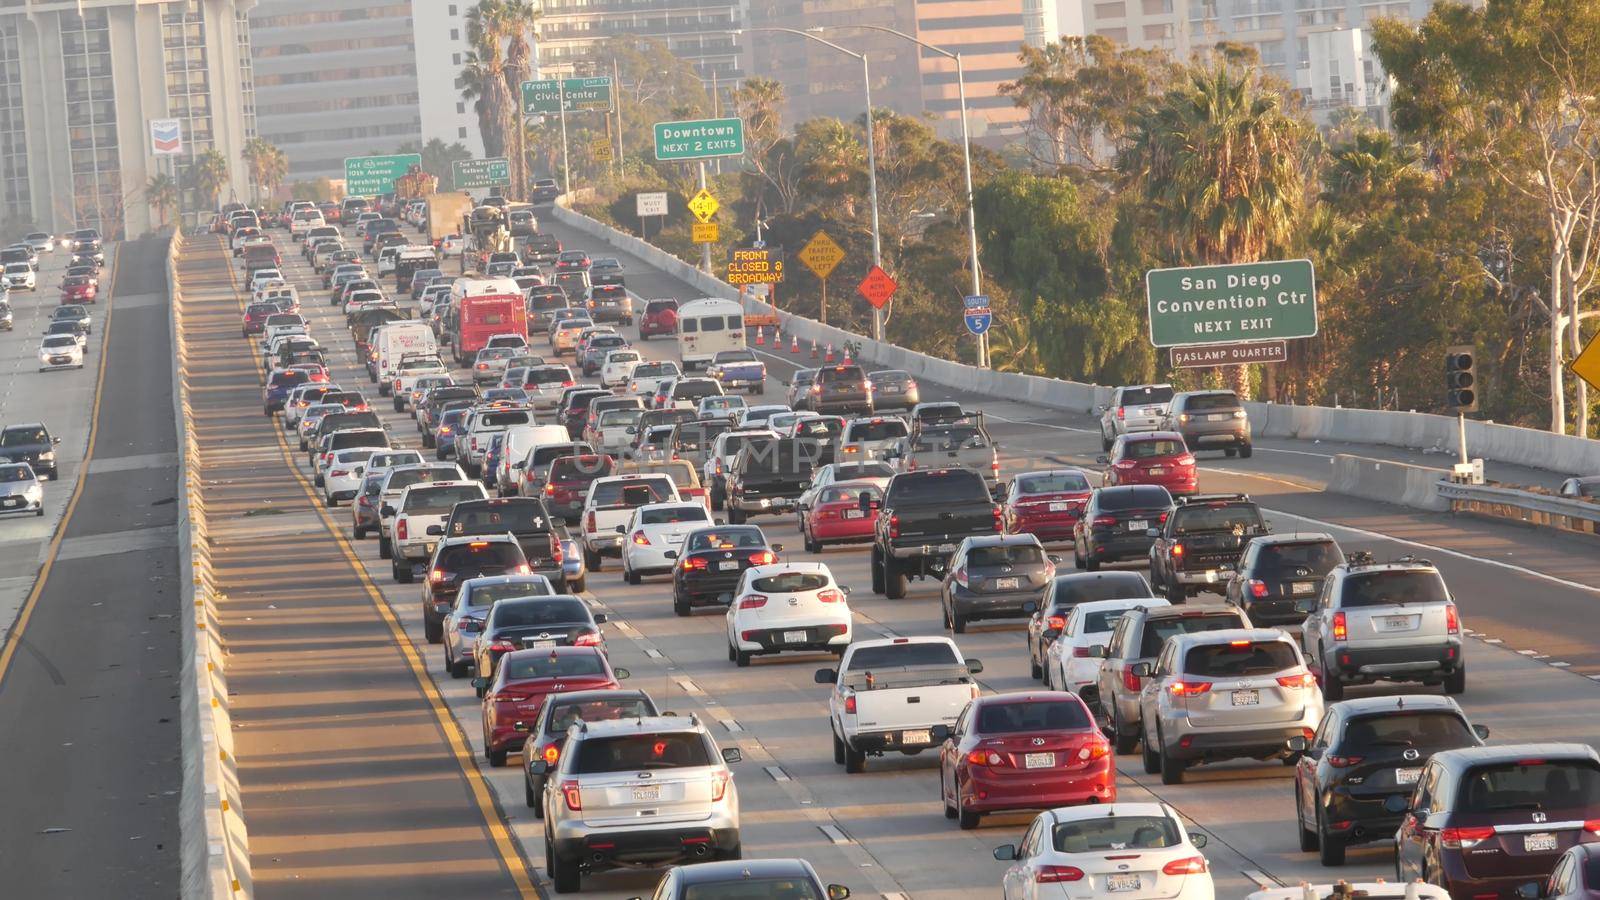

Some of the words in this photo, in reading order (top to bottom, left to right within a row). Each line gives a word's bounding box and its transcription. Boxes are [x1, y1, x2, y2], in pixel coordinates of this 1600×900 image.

[526, 82, 551, 91] Front
[535, 92, 559, 101] Civic
[566, 91, 598, 99] Center
[663, 126, 734, 139] Downtown
[596, 146, 610, 156] 45
[662, 143, 689, 153] NEXT
[694, 141, 703, 151] 2
[707, 140, 737, 150] EXITS
[734, 250, 769, 260] FRONT
[728, 261, 769, 272] CLOSED
[774, 261, 783, 272] @
[728, 272, 783, 283] BROADWAY
[1181, 276, 1217, 291] San
[1227, 273, 1282, 290] Diego
[967, 297, 987, 306] SOUTH
[1157, 294, 1267, 313] Convention
[1277, 291, 1307, 305] Ctr
[974, 319, 983, 330] 5
[1193, 320, 1232, 333] NEXT
[1241, 317, 1273, 330] EXIT
[1175, 350, 1227, 362] GASLAMP
[1232, 346, 1282, 359] QUARTER
